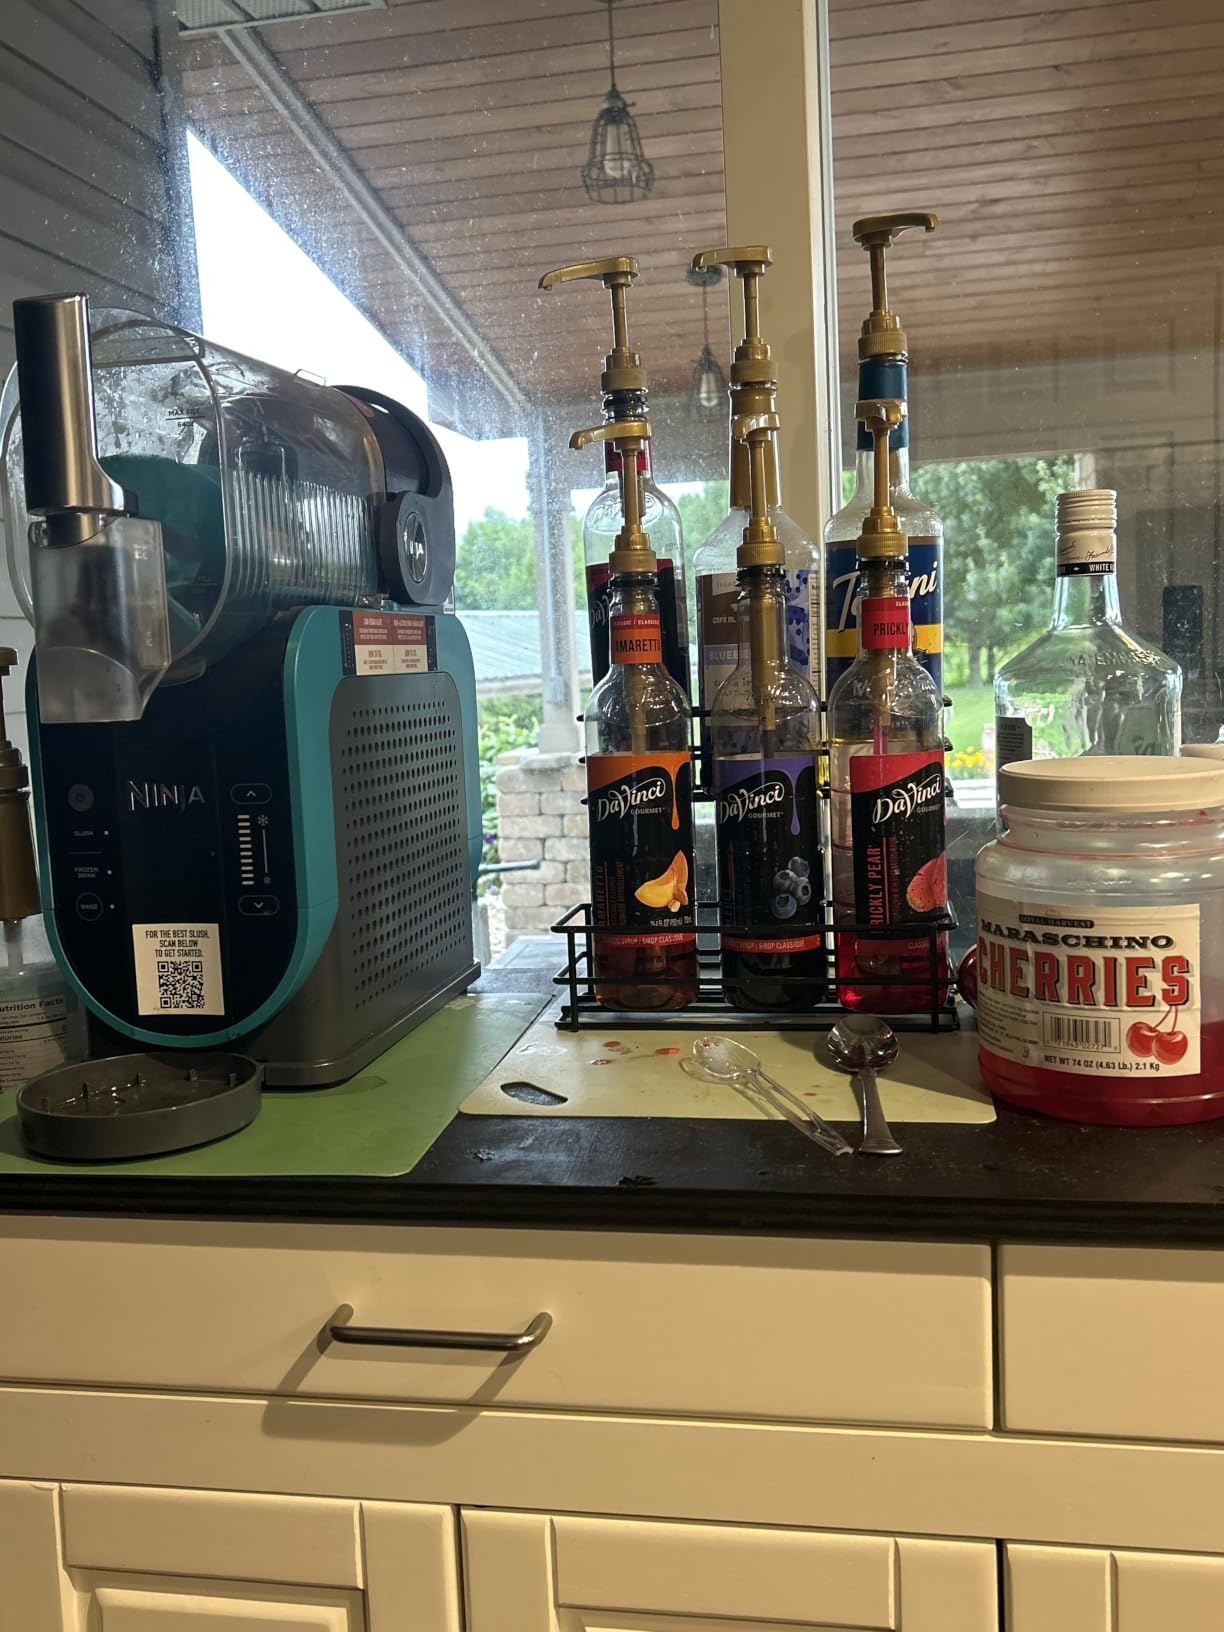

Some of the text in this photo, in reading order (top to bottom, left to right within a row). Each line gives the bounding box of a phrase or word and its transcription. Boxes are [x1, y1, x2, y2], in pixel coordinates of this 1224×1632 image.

[168, 409, 184, 417] MAX
[1088, 564, 1110, 572] WHITE
[129, 780, 206, 814] NINJA
[596, 777, 666, 822] DaVinci
[719, 781, 785, 825] DaVinci
[872, 773, 942, 824] DaVinci
[630, 807, 662, 815] GOURMET
[867, 848, 882, 878] PEAR
[1048, 919, 1092, 928] HARVEST
[146, 930, 210, 939] FOR THE BEST SLUSH,
[981, 920, 1174, 949] MARASCHINO
[776, 940, 804, 949] CLASSIQUE
[164, 949, 175, 957] GET
[978, 936, 1190, 1007] CHERRIES
[0, 1002, 36, 1012] utrition
[1044, 1055, 1057, 1063] NET
[1059, 1057, 1070, 1065] WT
[1084, 1060, 1094, 1068] OZ
[1096, 1061, 1116, 1070] (4.63
[1118, 1062, 1132, 1071] Lb.)
[1150, 1062, 1160, 1072] Kg
